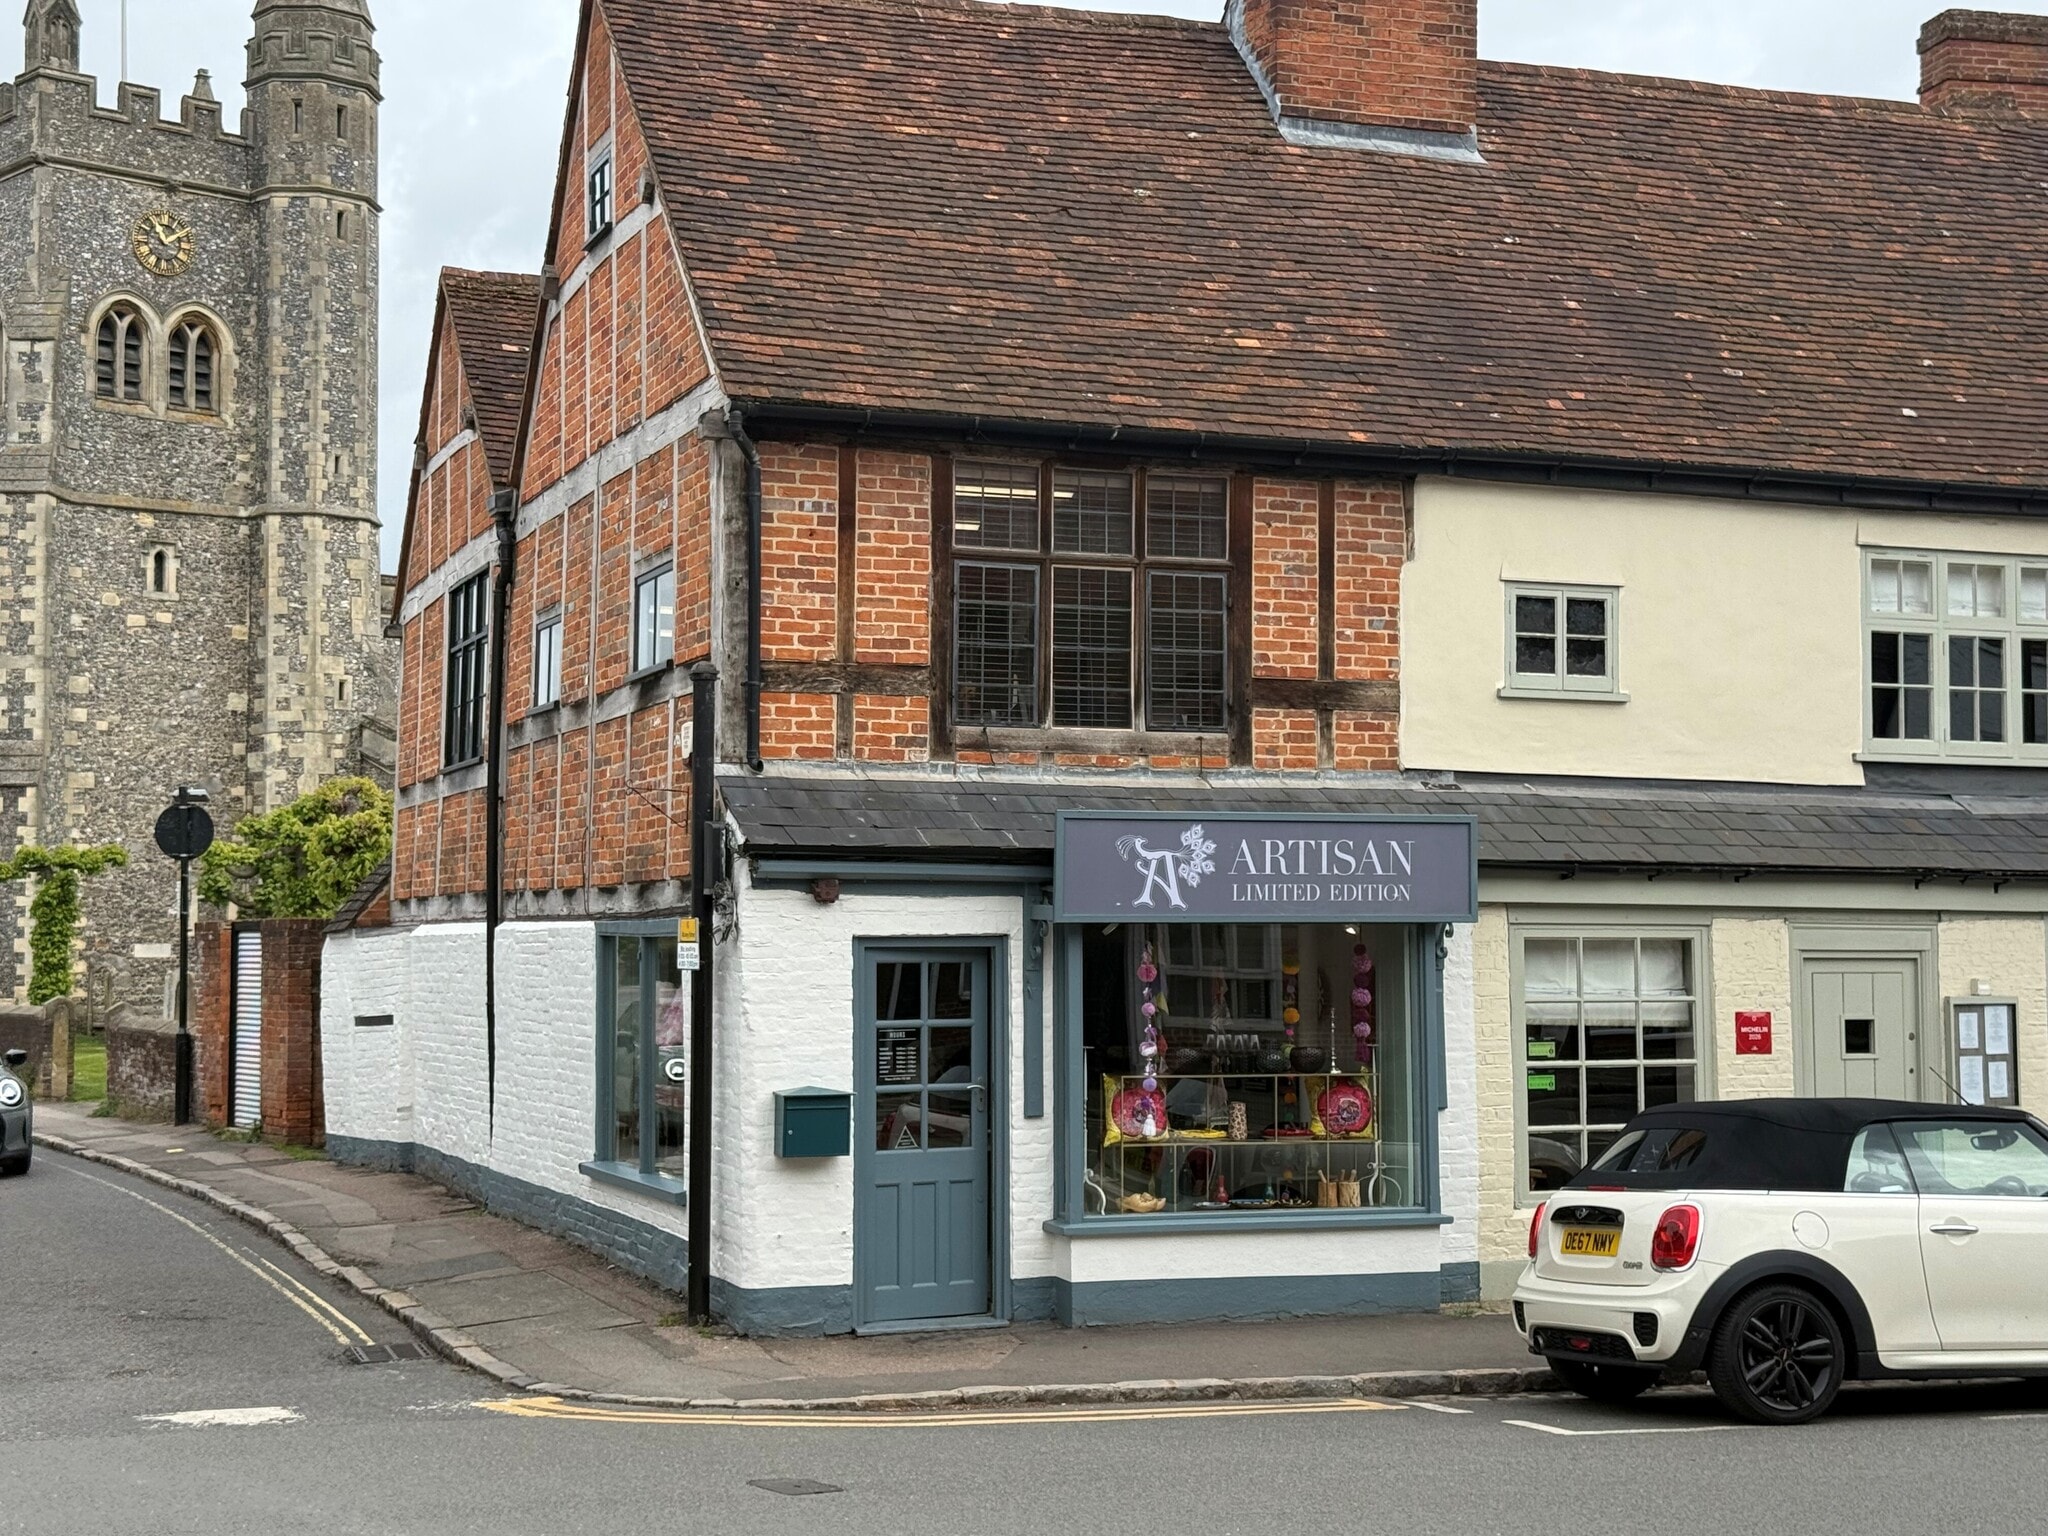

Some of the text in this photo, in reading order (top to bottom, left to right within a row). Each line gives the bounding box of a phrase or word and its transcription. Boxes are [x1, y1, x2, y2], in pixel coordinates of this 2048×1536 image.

[1228, 838, 1415, 877] ARTISAN
[1232, 883, 1412, 902] LIMITED EDITION
[1565, 1232, 1615, 1253] OE67 NMY
